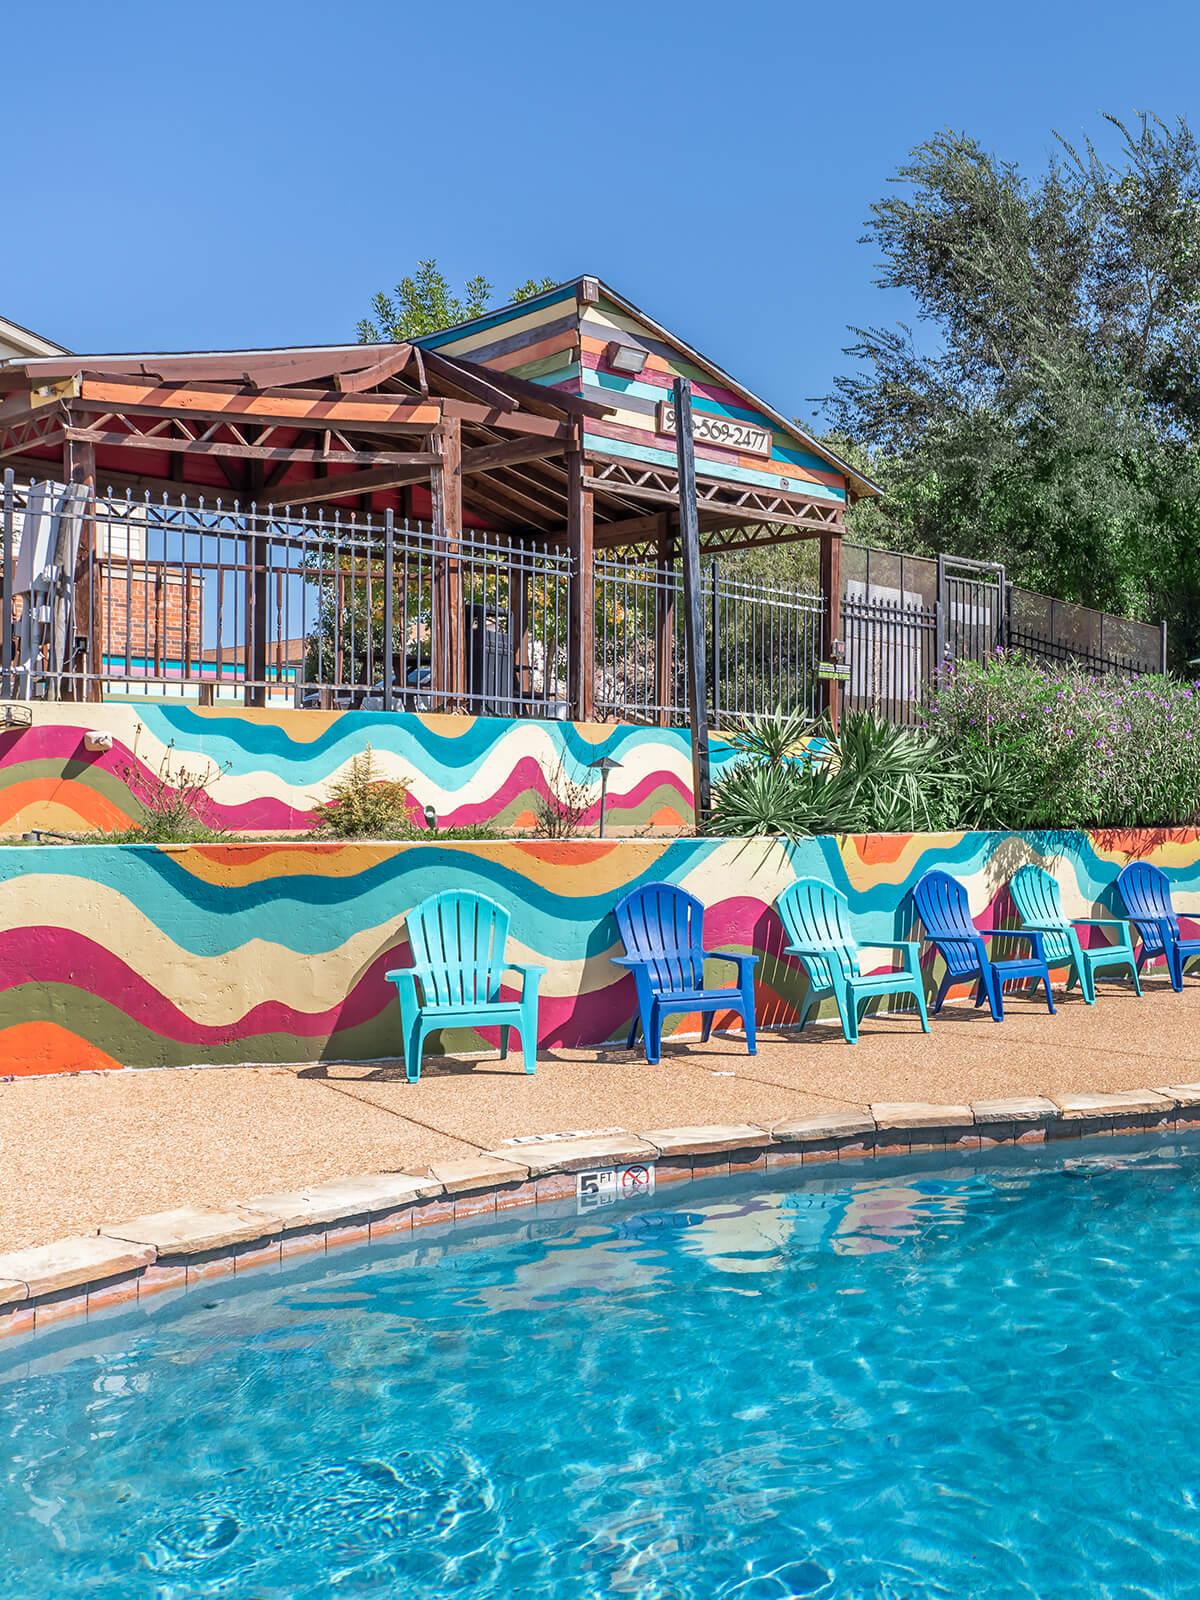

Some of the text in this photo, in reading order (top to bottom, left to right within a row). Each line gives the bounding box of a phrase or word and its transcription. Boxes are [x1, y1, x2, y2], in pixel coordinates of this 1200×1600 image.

[665, 410, 766, 450] 9-569-2477
[580, 1171, 613, 1195] 5 FT
